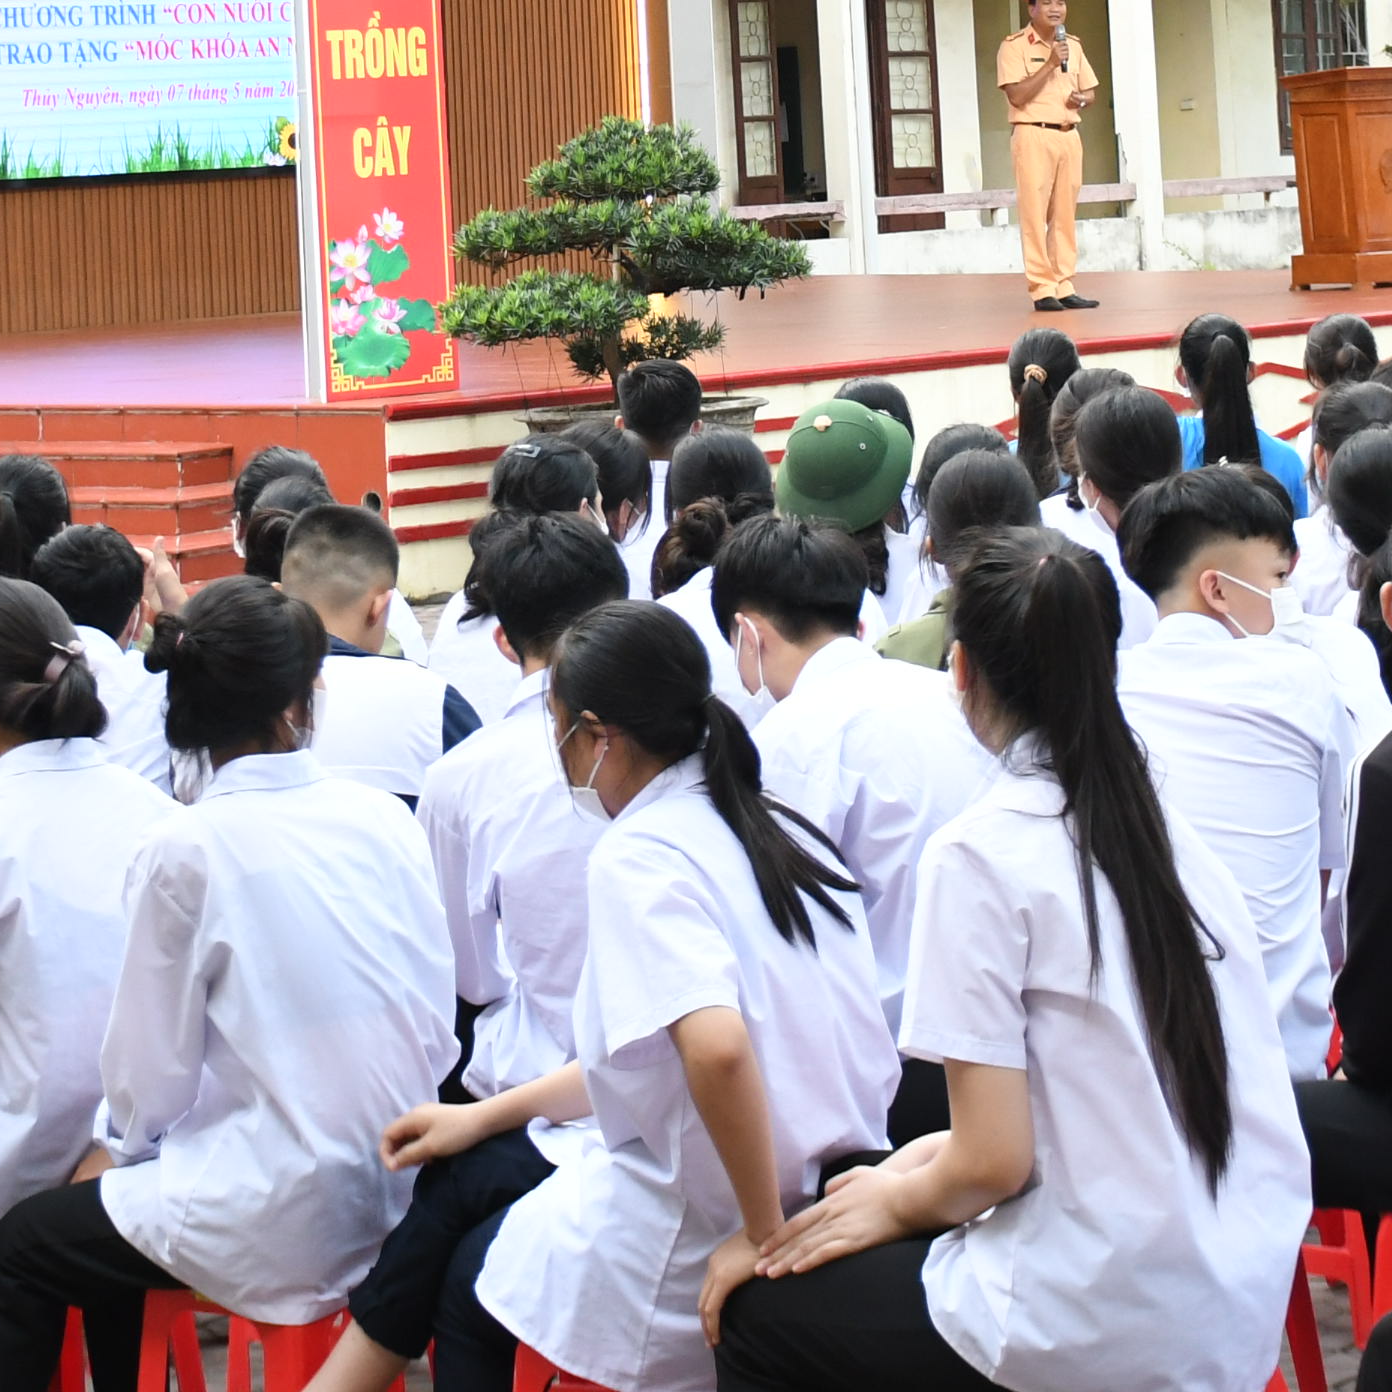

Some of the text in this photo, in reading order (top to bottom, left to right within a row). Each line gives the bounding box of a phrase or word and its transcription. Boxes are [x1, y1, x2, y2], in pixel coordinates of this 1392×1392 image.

[163, 2, 217, 25] “CON
[59, 38, 118, 69] TẶNG
[124, 33, 184, 61] “MÓC
[191, 32, 250, 60] KHÓA
[254, 36, 280, 58] AN
[326, 10, 428, 80] TRỒNG
[64, 86, 124, 110] Nguyên,
[128, 84, 163, 109] ngày
[167, 83, 185, 102] 07
[188, 82, 228, 105] tháng
[233, 81, 241, 100] 5
[245, 81, 274, 99] năm
[352, 116, 412, 179] CÂY
